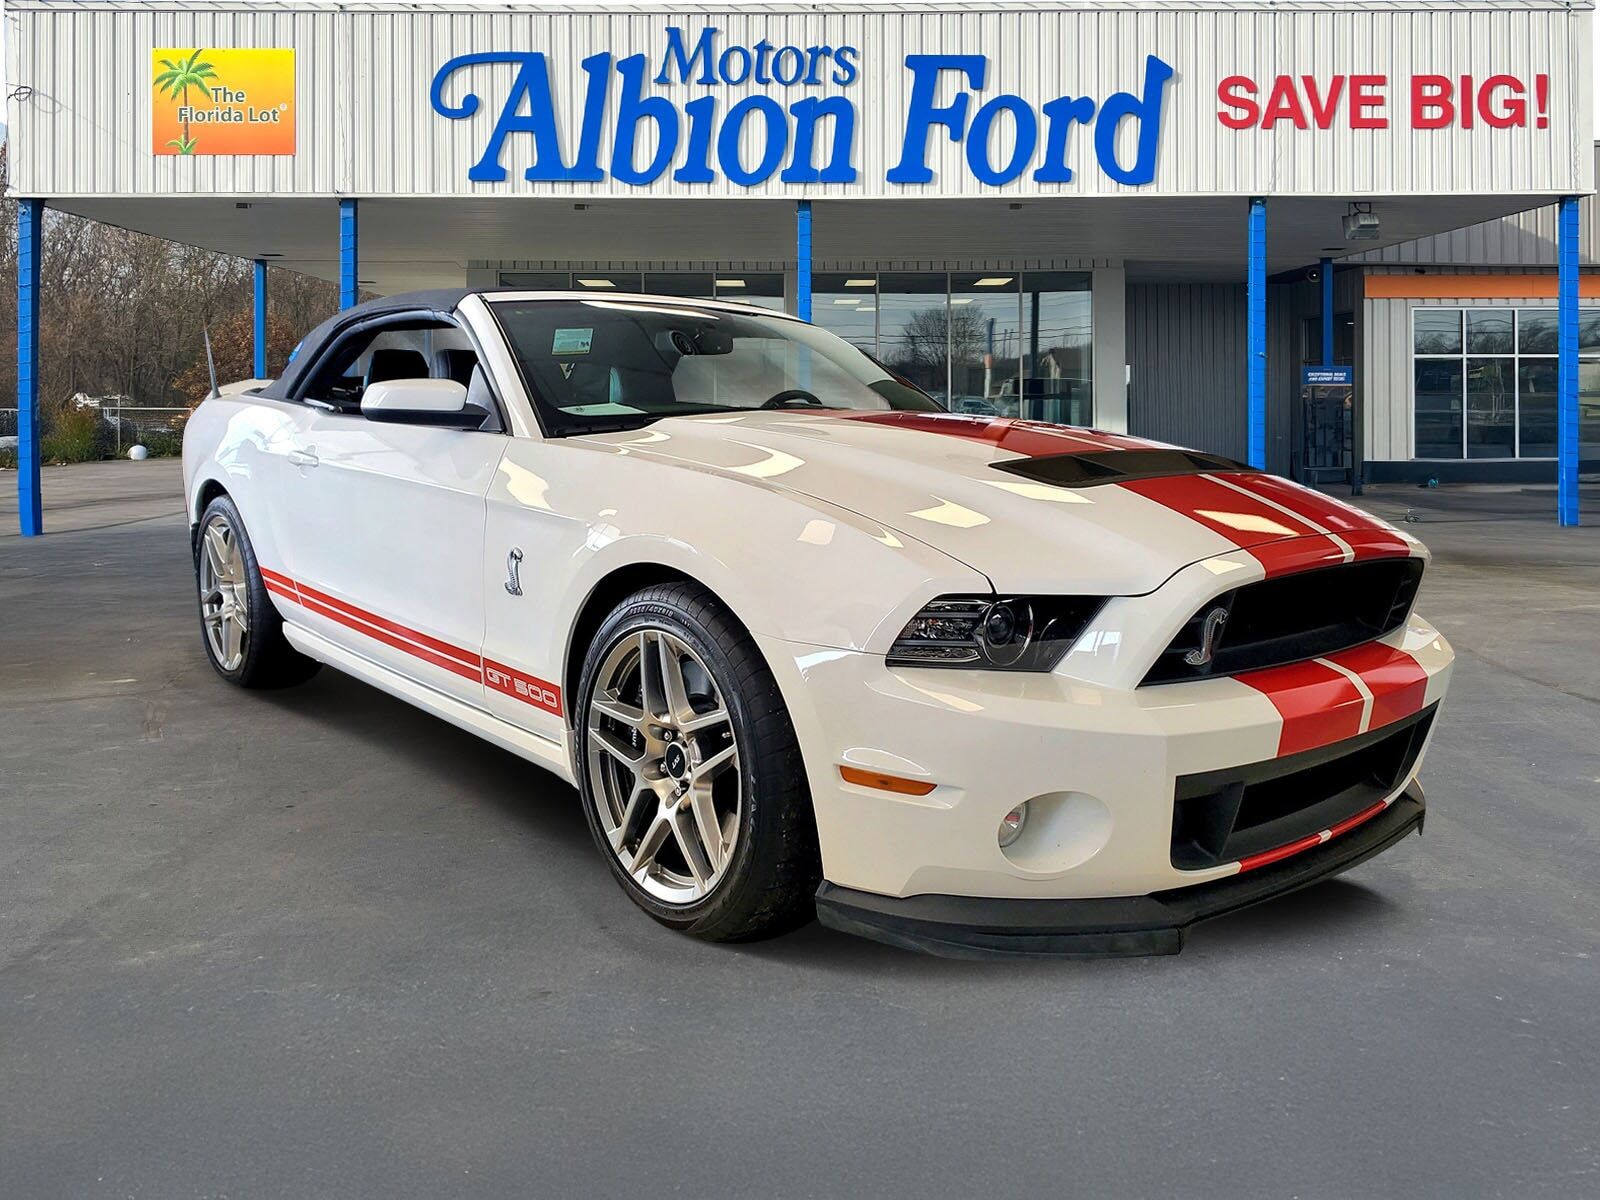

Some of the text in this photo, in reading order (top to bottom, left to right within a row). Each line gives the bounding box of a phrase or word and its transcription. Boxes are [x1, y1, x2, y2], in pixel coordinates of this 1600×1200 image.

[655, 27, 857, 85] Motors
[178, 106, 279, 122] Florida Lot
[210, 86, 246, 103] The
[430, 51, 1174, 186] Albion Ford
[1218, 74, 1548, 129] SAVE BIG!
[486, 667, 558, 708] GT 500
